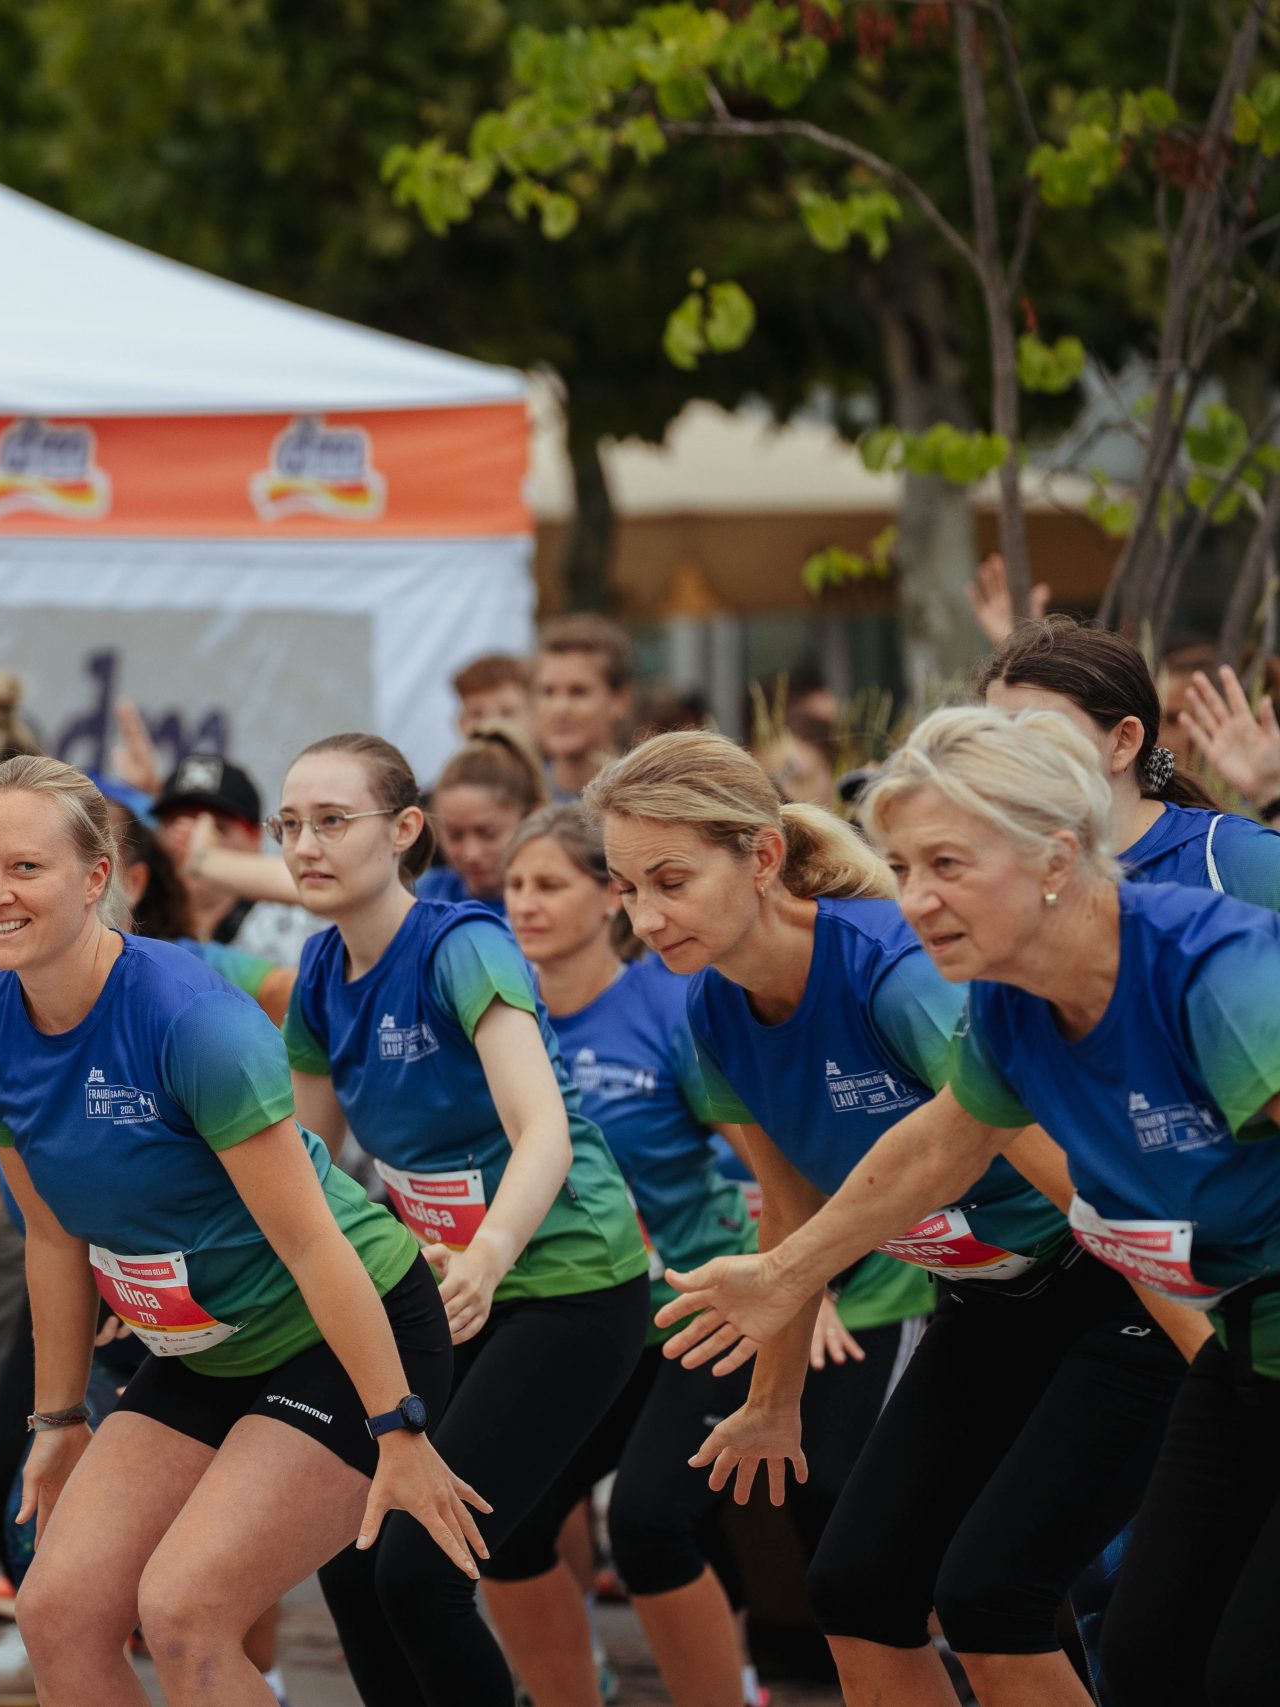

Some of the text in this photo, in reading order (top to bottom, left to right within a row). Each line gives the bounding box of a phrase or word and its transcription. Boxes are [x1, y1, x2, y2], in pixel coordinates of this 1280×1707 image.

[276, 416, 365, 481] dm
[381, 1042, 403, 1057] LAUF
[89, 1066, 103, 1078] dm
[828, 1079, 856, 1093] FRAUEN
[831, 1091, 859, 1108] LAUF
[1137, 1126, 1169, 1148] LAUF
[400, 1193, 457, 1228] Luisa
[111, 1279, 163, 1310] Nina
[137, 1311, 158, 1325] 779
[279, 1396, 334, 1424] hummel
